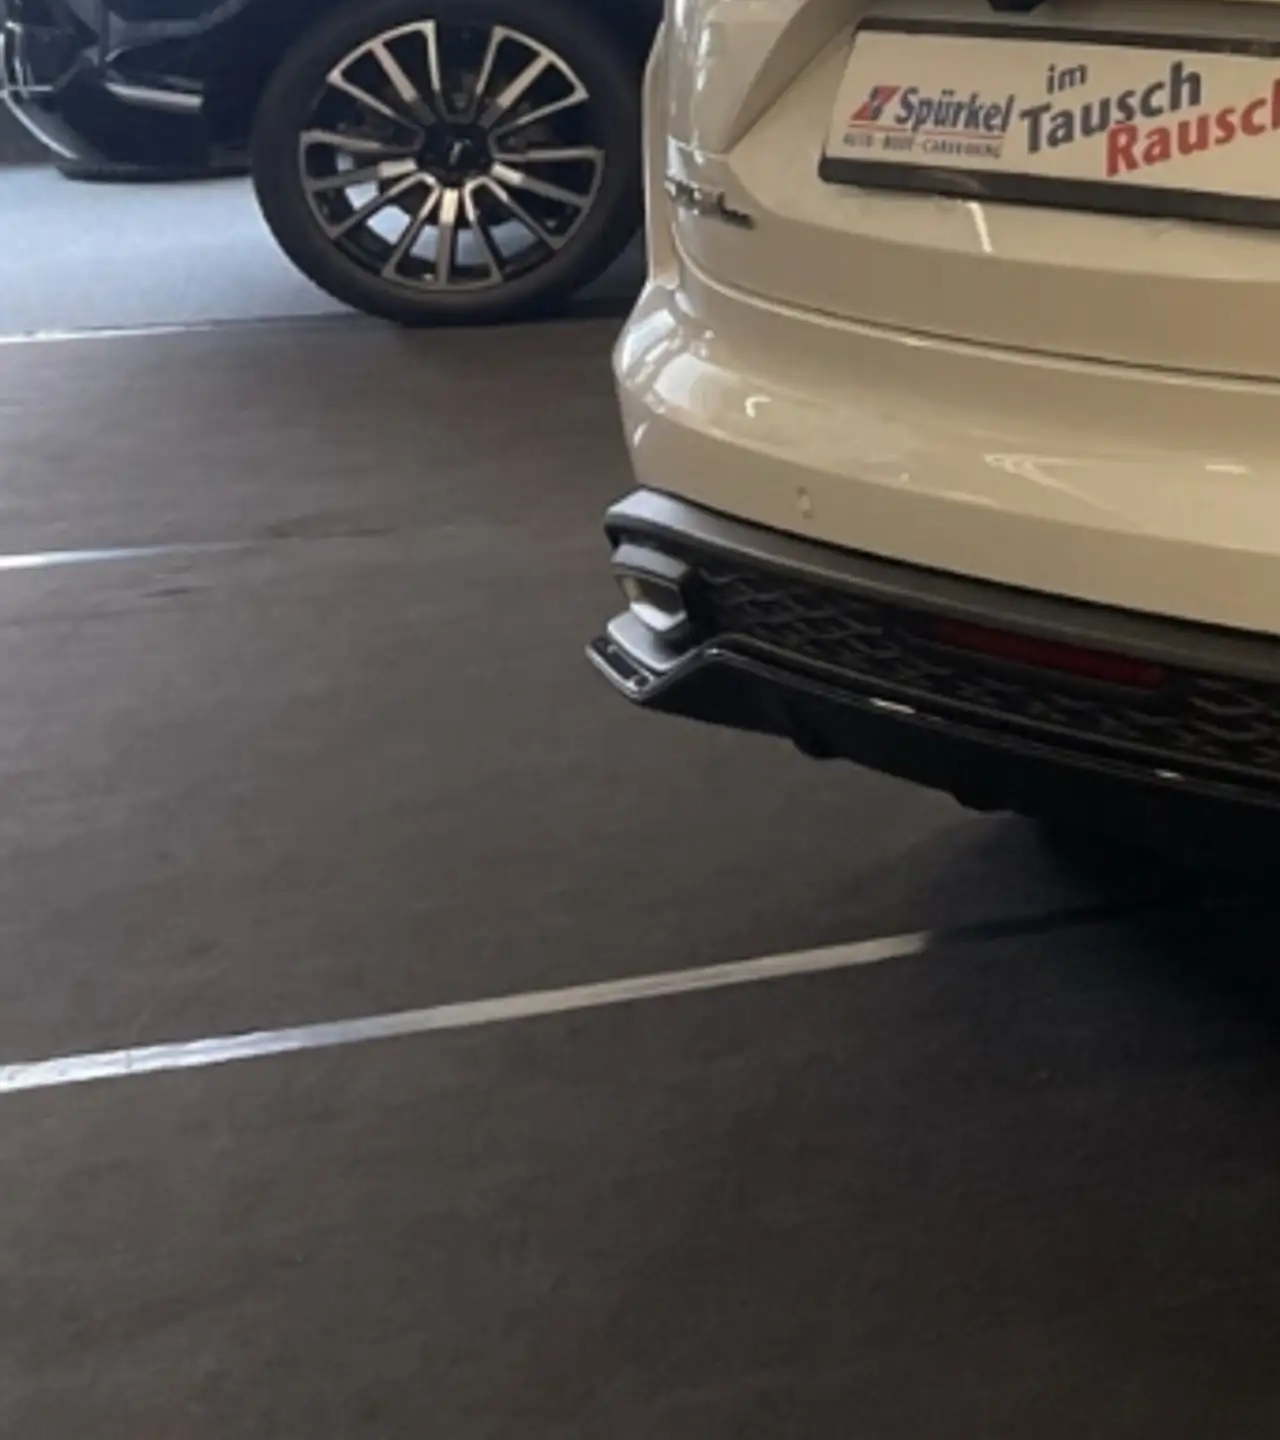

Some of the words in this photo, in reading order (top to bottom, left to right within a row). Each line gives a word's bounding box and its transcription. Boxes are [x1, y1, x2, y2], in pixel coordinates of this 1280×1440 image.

[1047, 63, 1087, 94] im
[894, 86, 1015, 133] Spürkel
[1019, 60, 1201, 155] Tausch
